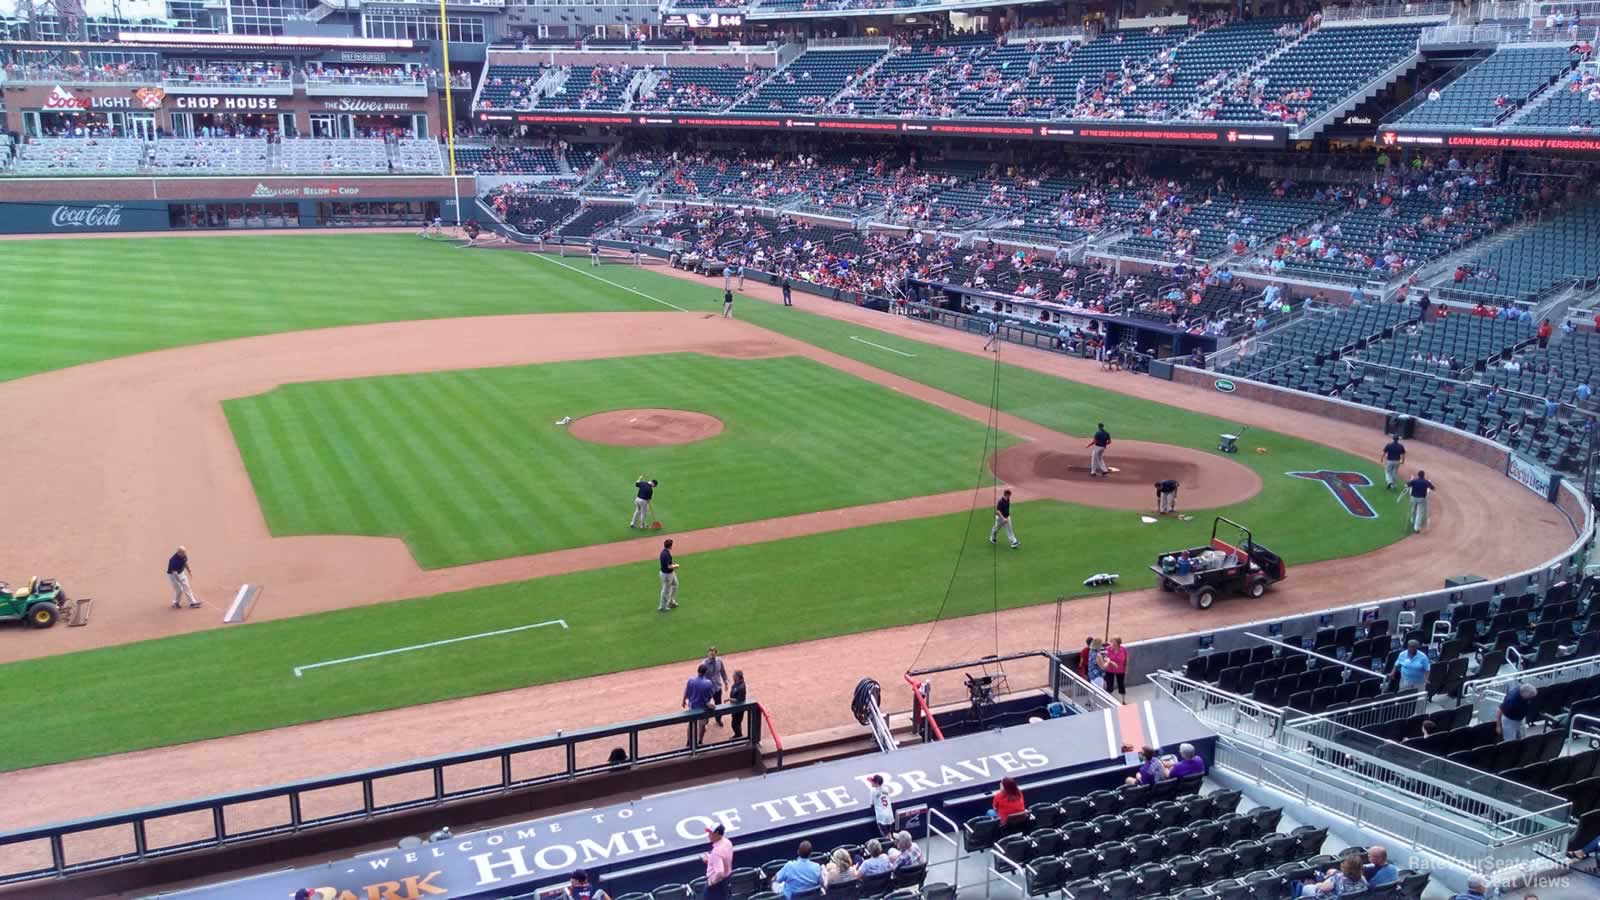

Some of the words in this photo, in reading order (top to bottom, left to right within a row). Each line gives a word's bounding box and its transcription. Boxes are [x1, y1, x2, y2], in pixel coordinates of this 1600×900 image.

[721, 16, 741, 26] 6:46
[47, 92, 91, 109] Coors
[91, 97, 131, 107] LIGHT
[177, 97, 219, 109] CHOP
[225, 98, 278, 109] HOUSE
[339, 97, 384, 111] Silver
[1511, 139, 1545, 147] MASSEY
[52, 204, 121, 226] Coca-Cola
[1528, 473, 1550, 497] LIGHT
[469, 825, 665, 886] HOME
[675, 806, 744, 840] OF
[751, 785, 858, 823] THE
[855, 747, 1049, 797] BRAVES
[368, 822, 563, 870] WELCOME
[592, 808, 633, 824] TO
